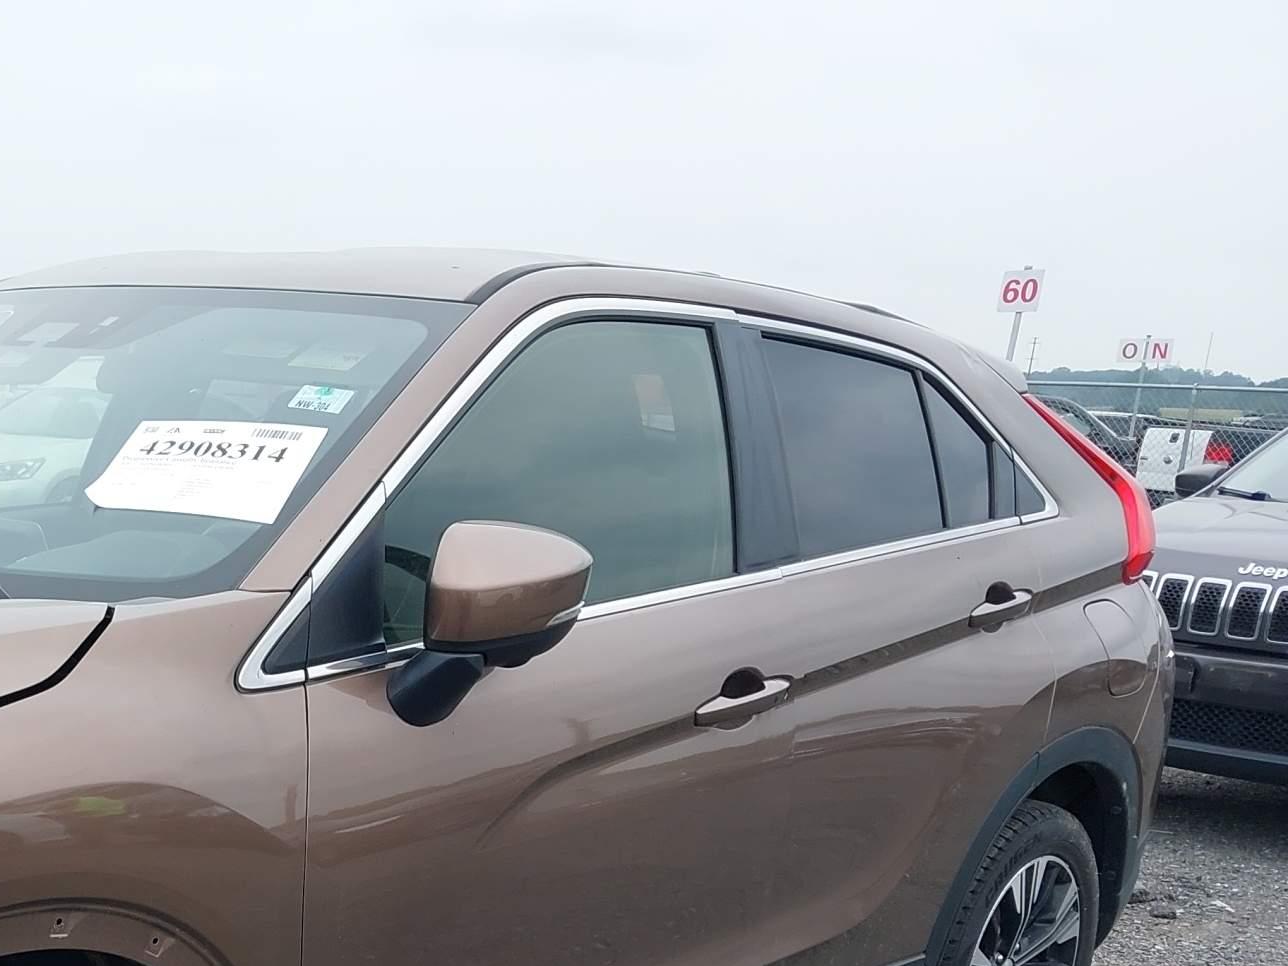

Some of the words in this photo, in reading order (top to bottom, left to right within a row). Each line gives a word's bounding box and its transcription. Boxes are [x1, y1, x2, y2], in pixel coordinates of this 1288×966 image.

[1002, 278, 1039, 303] 60
[1151, 342, 1169, 359] N
[139, 439, 289, 463] 42908314
[1238, 562, 1288, 580] Jeep
